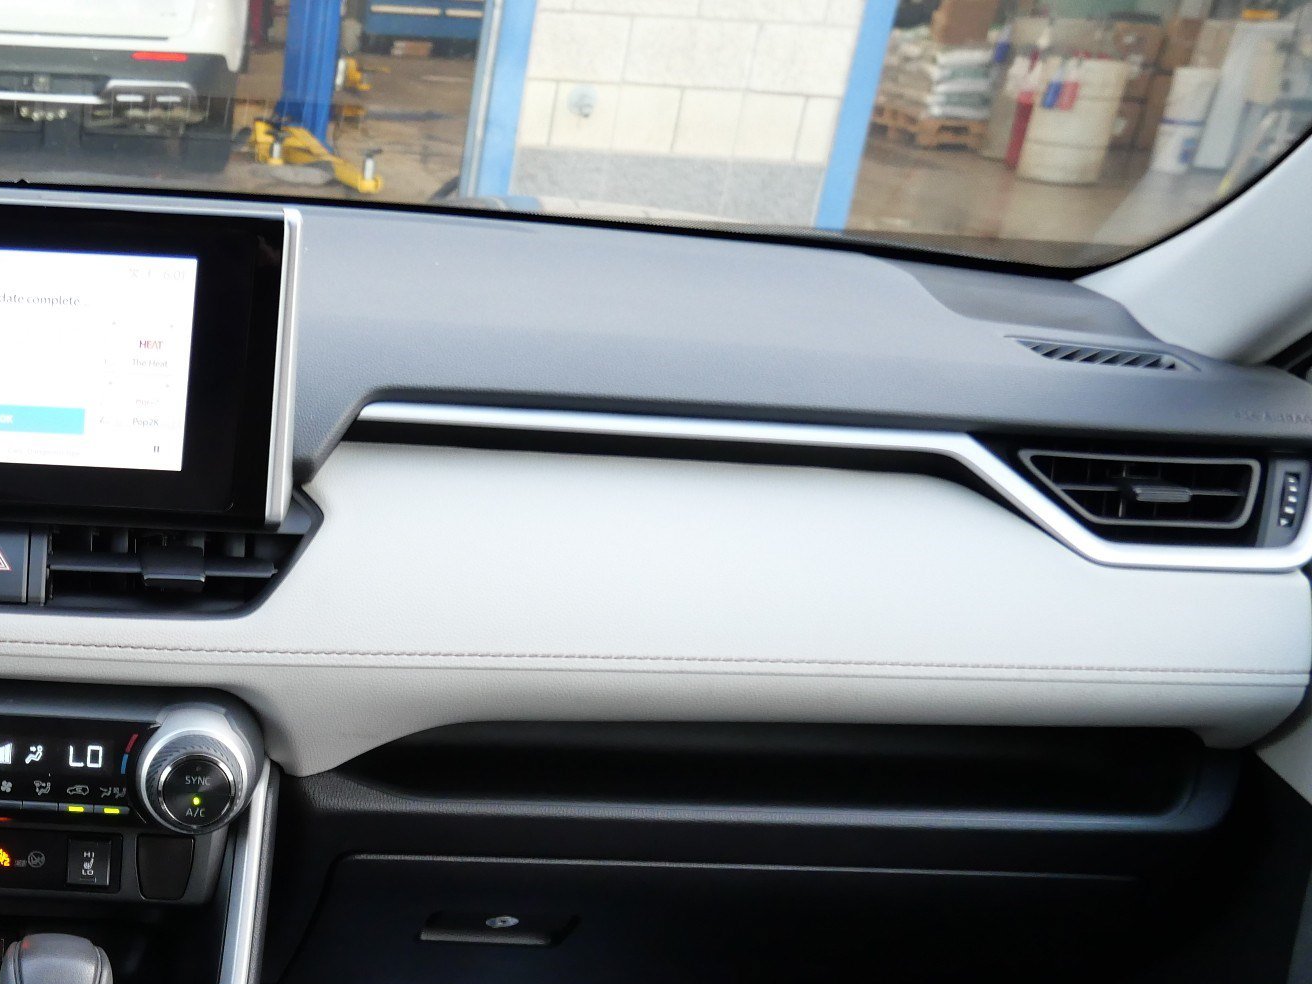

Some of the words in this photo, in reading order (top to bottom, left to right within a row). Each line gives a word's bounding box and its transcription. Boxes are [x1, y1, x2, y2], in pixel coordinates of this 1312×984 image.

[26, 295, 80, 307] complete
[139, 340, 163, 350] HEAT
[69, 744, 103, 769] LO
[185, 776, 211, 786] SYNC
[185, 808, 206, 818] A/C
[81, 868, 94, 876] LO
